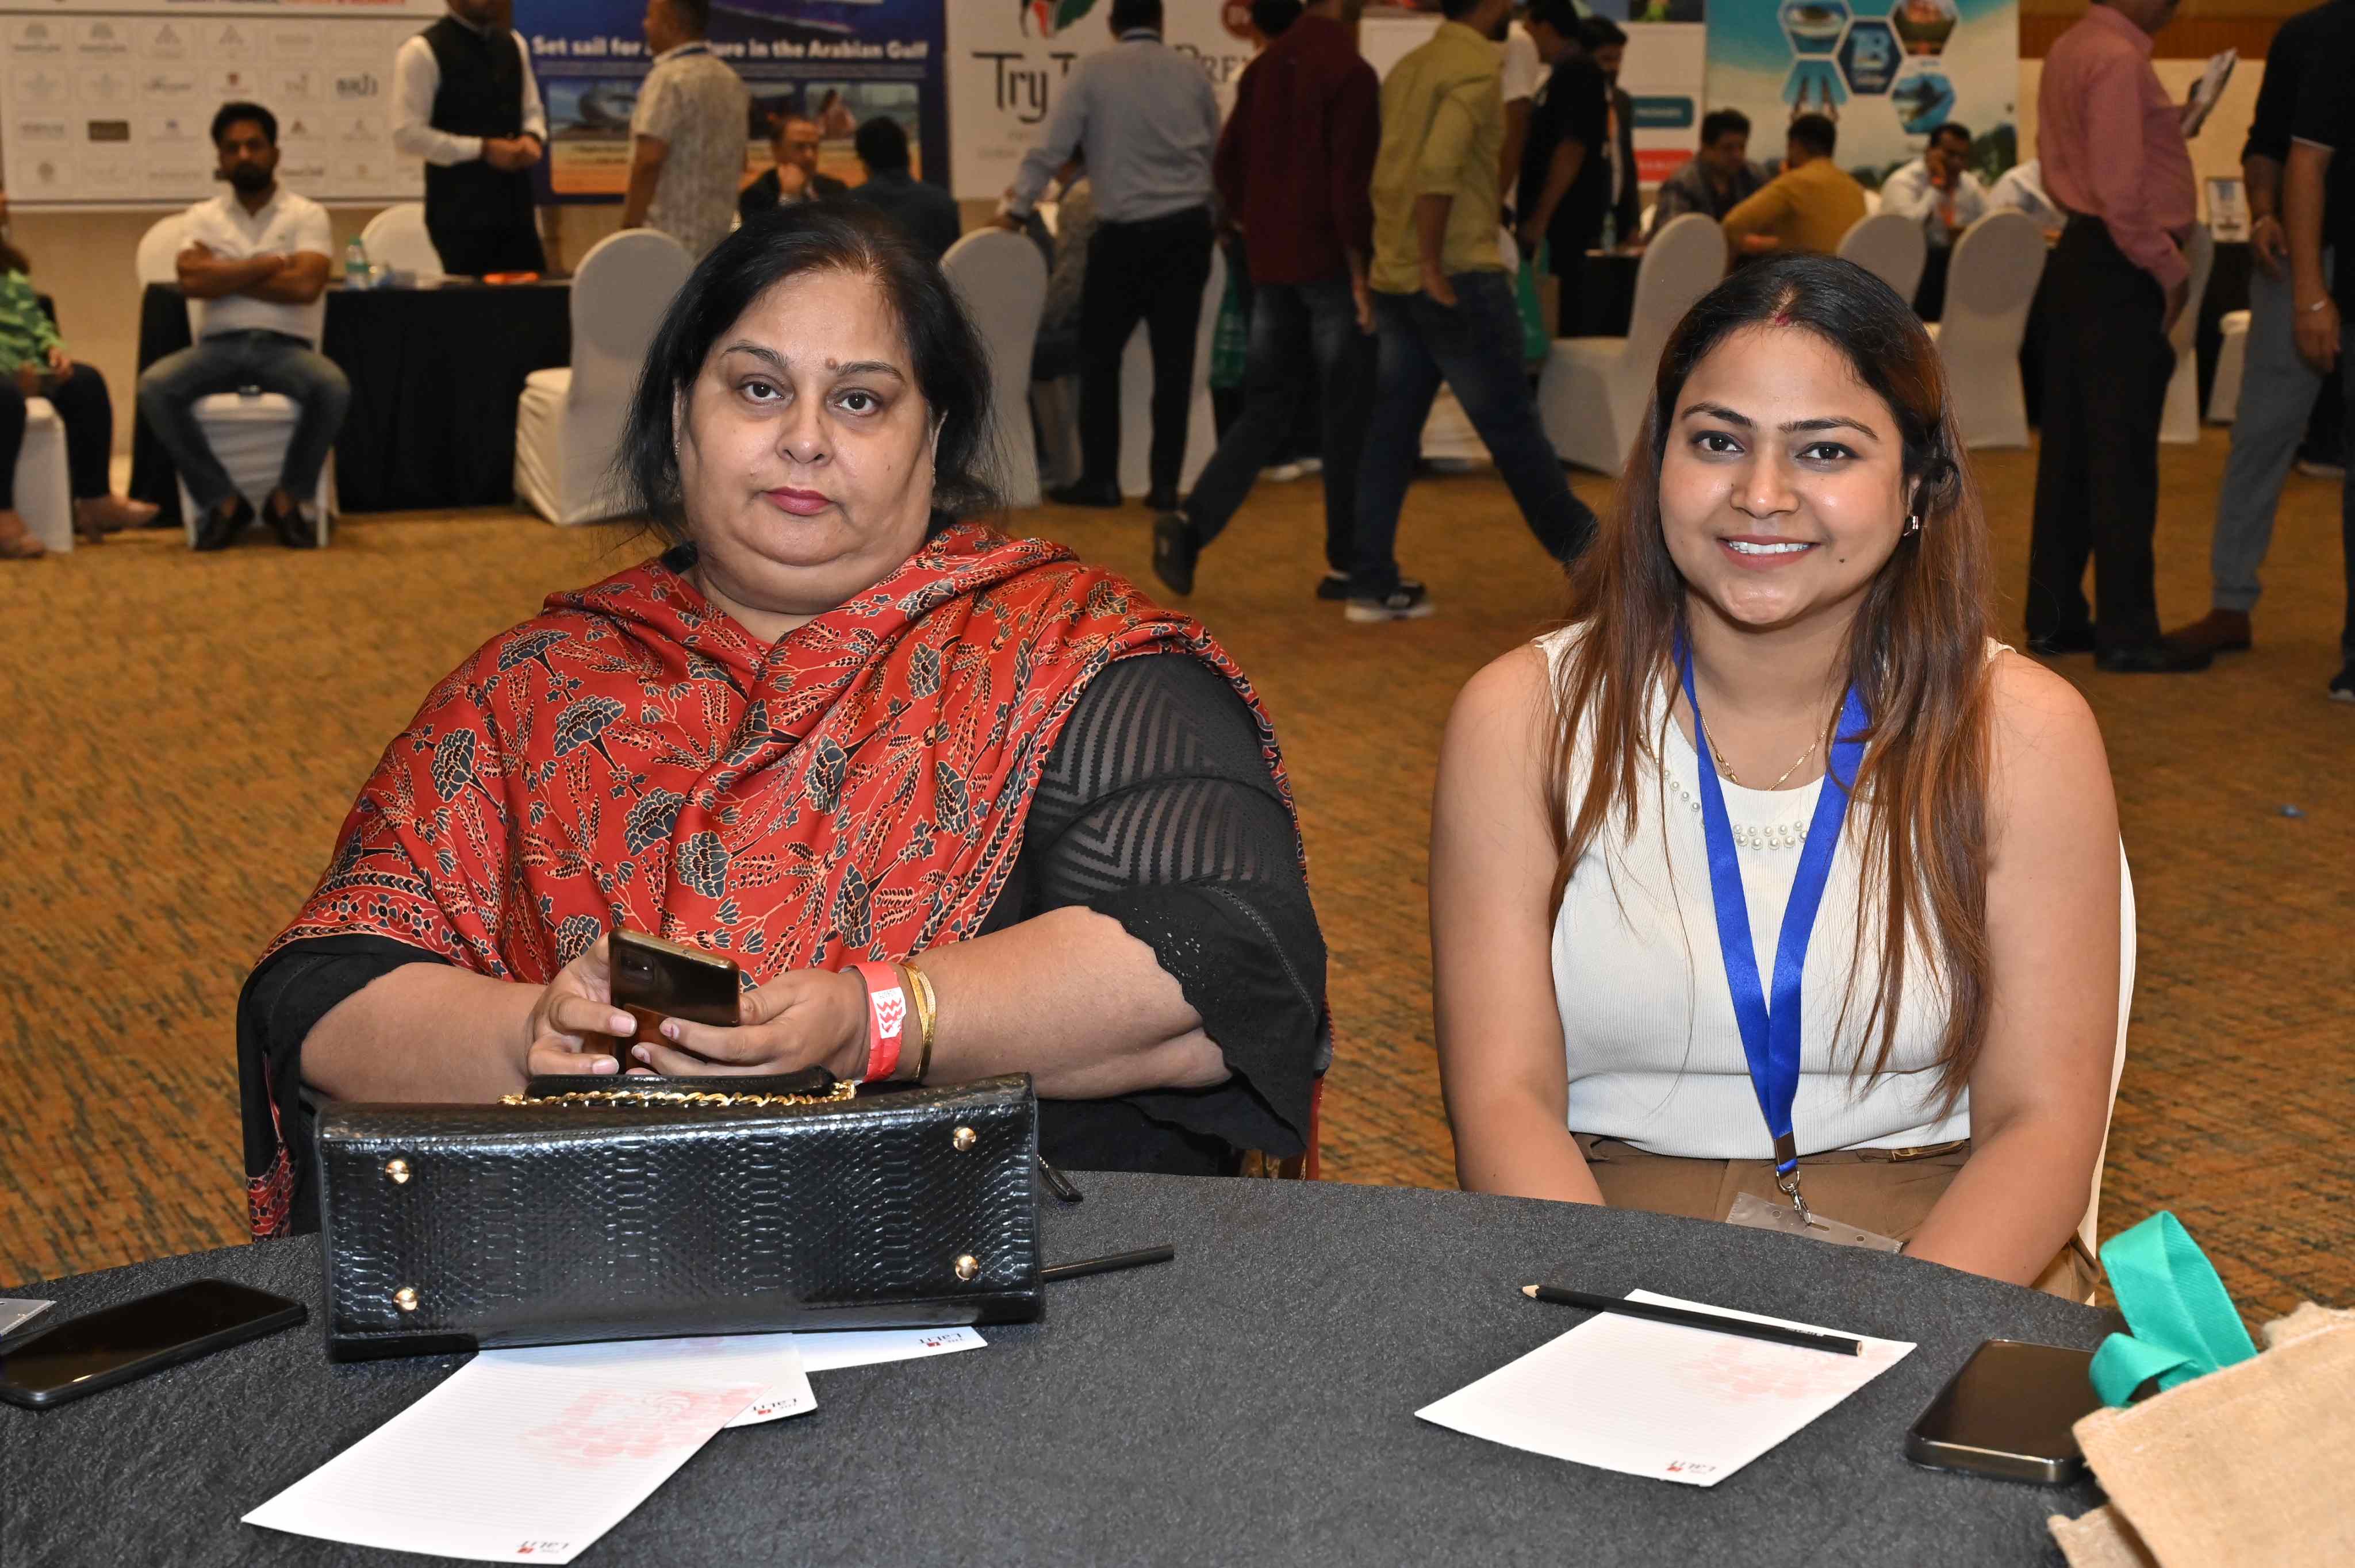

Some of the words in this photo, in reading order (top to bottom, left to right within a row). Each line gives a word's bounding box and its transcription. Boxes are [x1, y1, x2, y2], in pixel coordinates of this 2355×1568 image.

[532, 35, 566, 55] Set
[572, 36, 607, 56] sail
[610, 37, 640, 56] for
[749, 38, 769, 57] in
[772, 39, 804, 57] the
[808, 39, 884, 57] Arabian
[886, 39, 929, 59] Gulf
[972, 52, 1048, 124] Try
